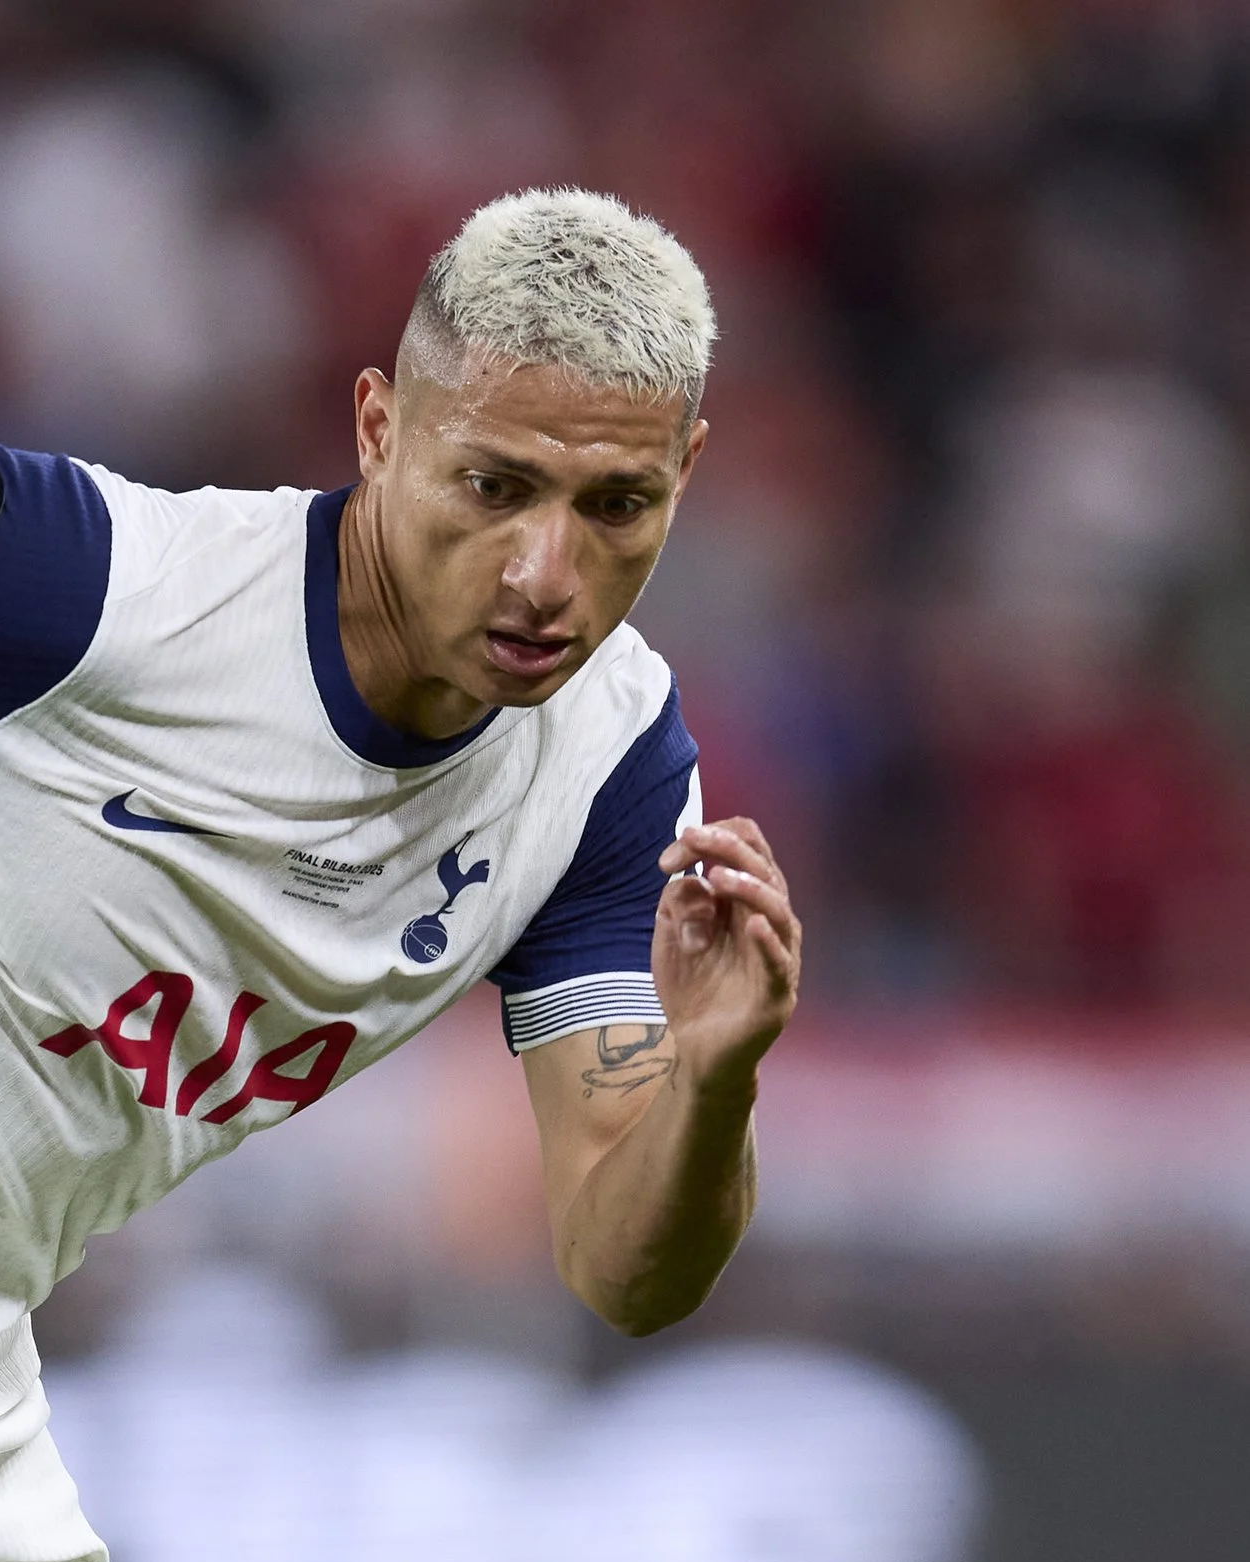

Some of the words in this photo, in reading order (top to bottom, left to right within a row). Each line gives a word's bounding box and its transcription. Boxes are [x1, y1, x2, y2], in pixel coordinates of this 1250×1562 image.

[283, 849, 319, 867] FINAL
[321, 859, 360, 874] BILBAO
[359, 864, 385, 876] 2025
[38, 970, 357, 1125] AIA
